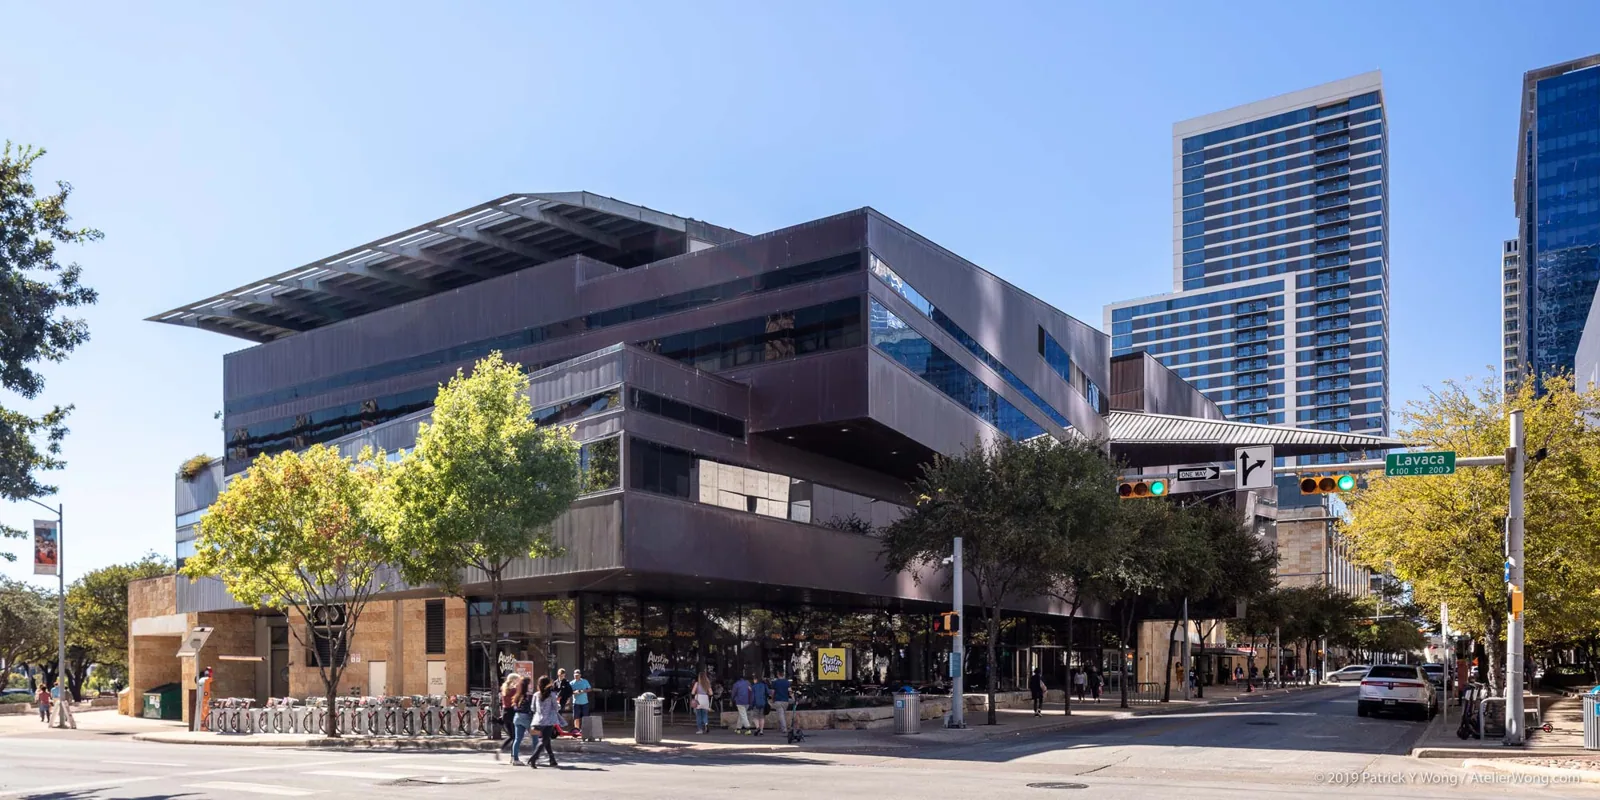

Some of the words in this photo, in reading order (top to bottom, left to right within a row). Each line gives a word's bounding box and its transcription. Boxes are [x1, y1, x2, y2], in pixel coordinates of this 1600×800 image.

[1396, 455, 1445, 466] Lavaca
[1428, 466, 1444, 474] 200
[647, 651, 669, 664] Austin
[821, 653, 843, 667] Austin
[823, 664, 840, 675] JAVA
